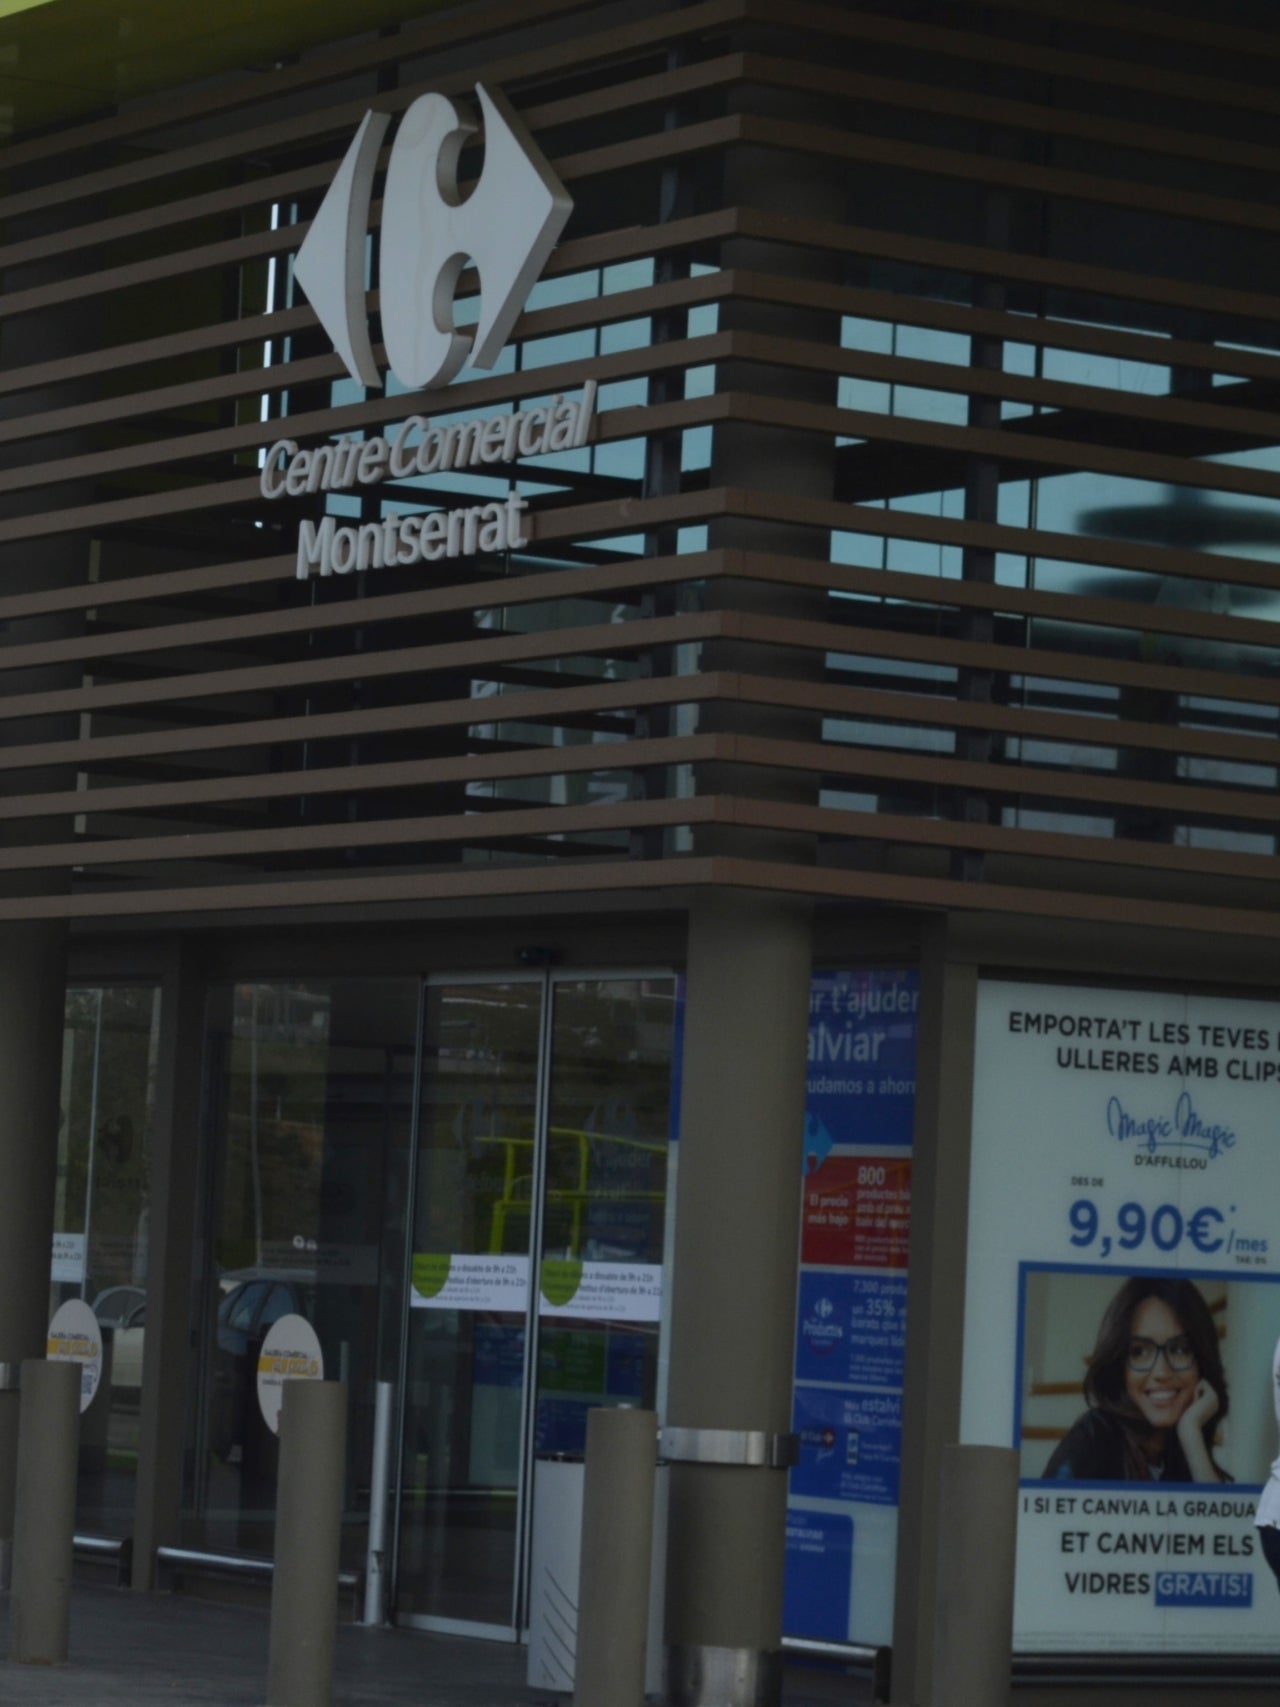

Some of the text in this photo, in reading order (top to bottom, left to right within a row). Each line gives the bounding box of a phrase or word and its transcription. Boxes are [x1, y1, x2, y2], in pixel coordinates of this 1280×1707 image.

[260, 379, 598, 500] Centre Comercial
[296, 491, 529, 581] Montserrat
[1009, 1011, 1142, 1042] EMPORTA'T
[1149, 1021, 1190, 1046] LES
[1198, 1025, 1270, 1052] TEVES
[1057, 1046, 1160, 1076] ULLERES
[1167, 1055, 1219, 1079] AMB
[1134, 1154, 1207, 1171] D'AFFLELOU
[857, 1165, 885, 1186] 800
[865, 1297, 895, 1318] 35%
[1023, 1497, 1029, 1513] I
[1034, 1497, 1050, 1514] SI
[1055, 1497, 1078, 1515] ET
[1082, 1498, 1150, 1517] CANVIA
[1156, 1499, 1178, 1517] LA
[1061, 1532, 1254, 1557] ET CANVIEM ELS
[1064, 1572, 1249, 1598] VIDRES GRATIS!
